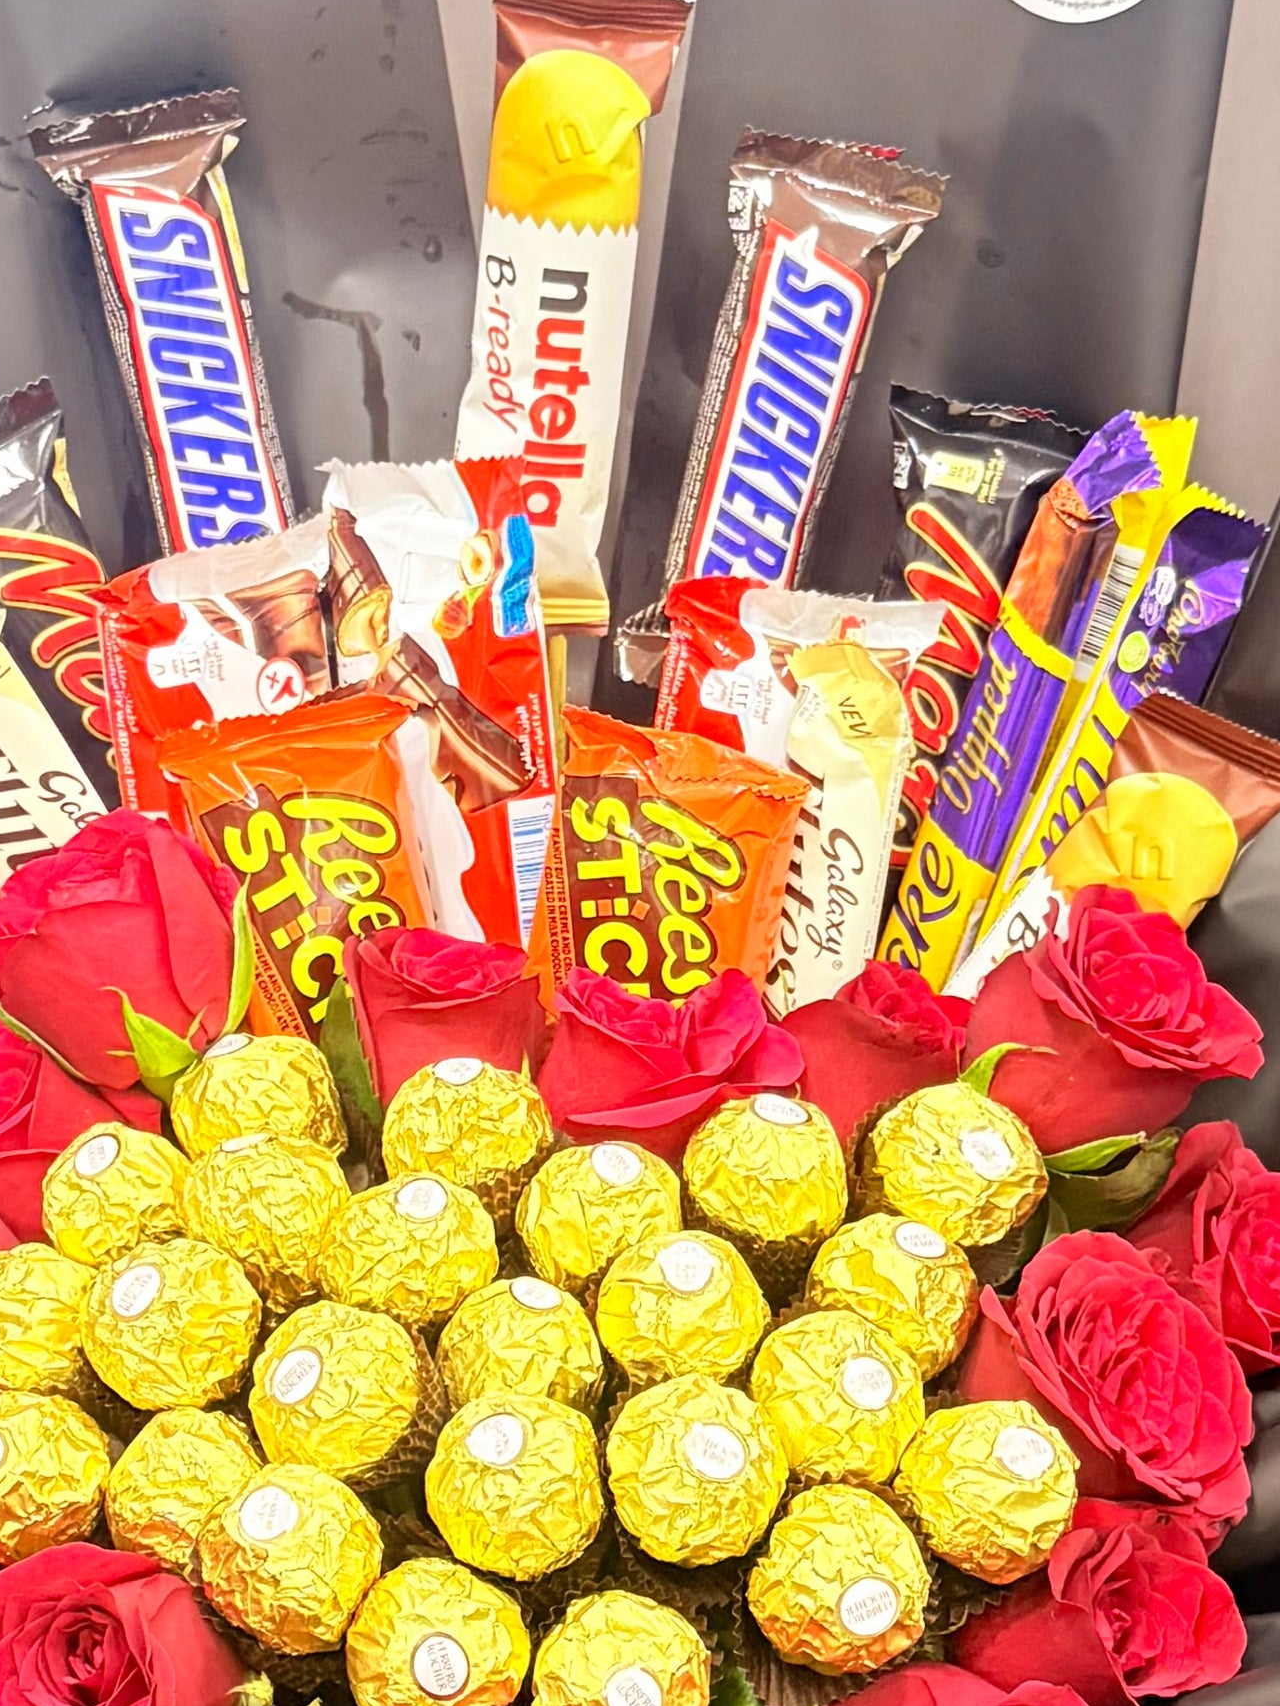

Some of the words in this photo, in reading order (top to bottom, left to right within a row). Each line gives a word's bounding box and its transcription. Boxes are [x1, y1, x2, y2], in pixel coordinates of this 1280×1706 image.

[482, 254, 525, 435] B-ready
[120, 207, 274, 549] SNICKERS
[520, 267, 591, 527] nutella
[940, 631, 1017, 814] Dipped
[550, 827, 562, 865] PEANUT
[543, 866, 554, 901] COATED
[546, 904, 555, 914] IN
[554, 867, 566, 902] BUTTER
[806, 828, 864, 959] Galaxy
[558, 904, 569, 933] CREME
[561, 936, 571, 955] AND
[256, 979, 290, 1032] CHOCOLATE
[266, 972, 282, 993] AND
[276, 992, 298, 1023] CRISPY
